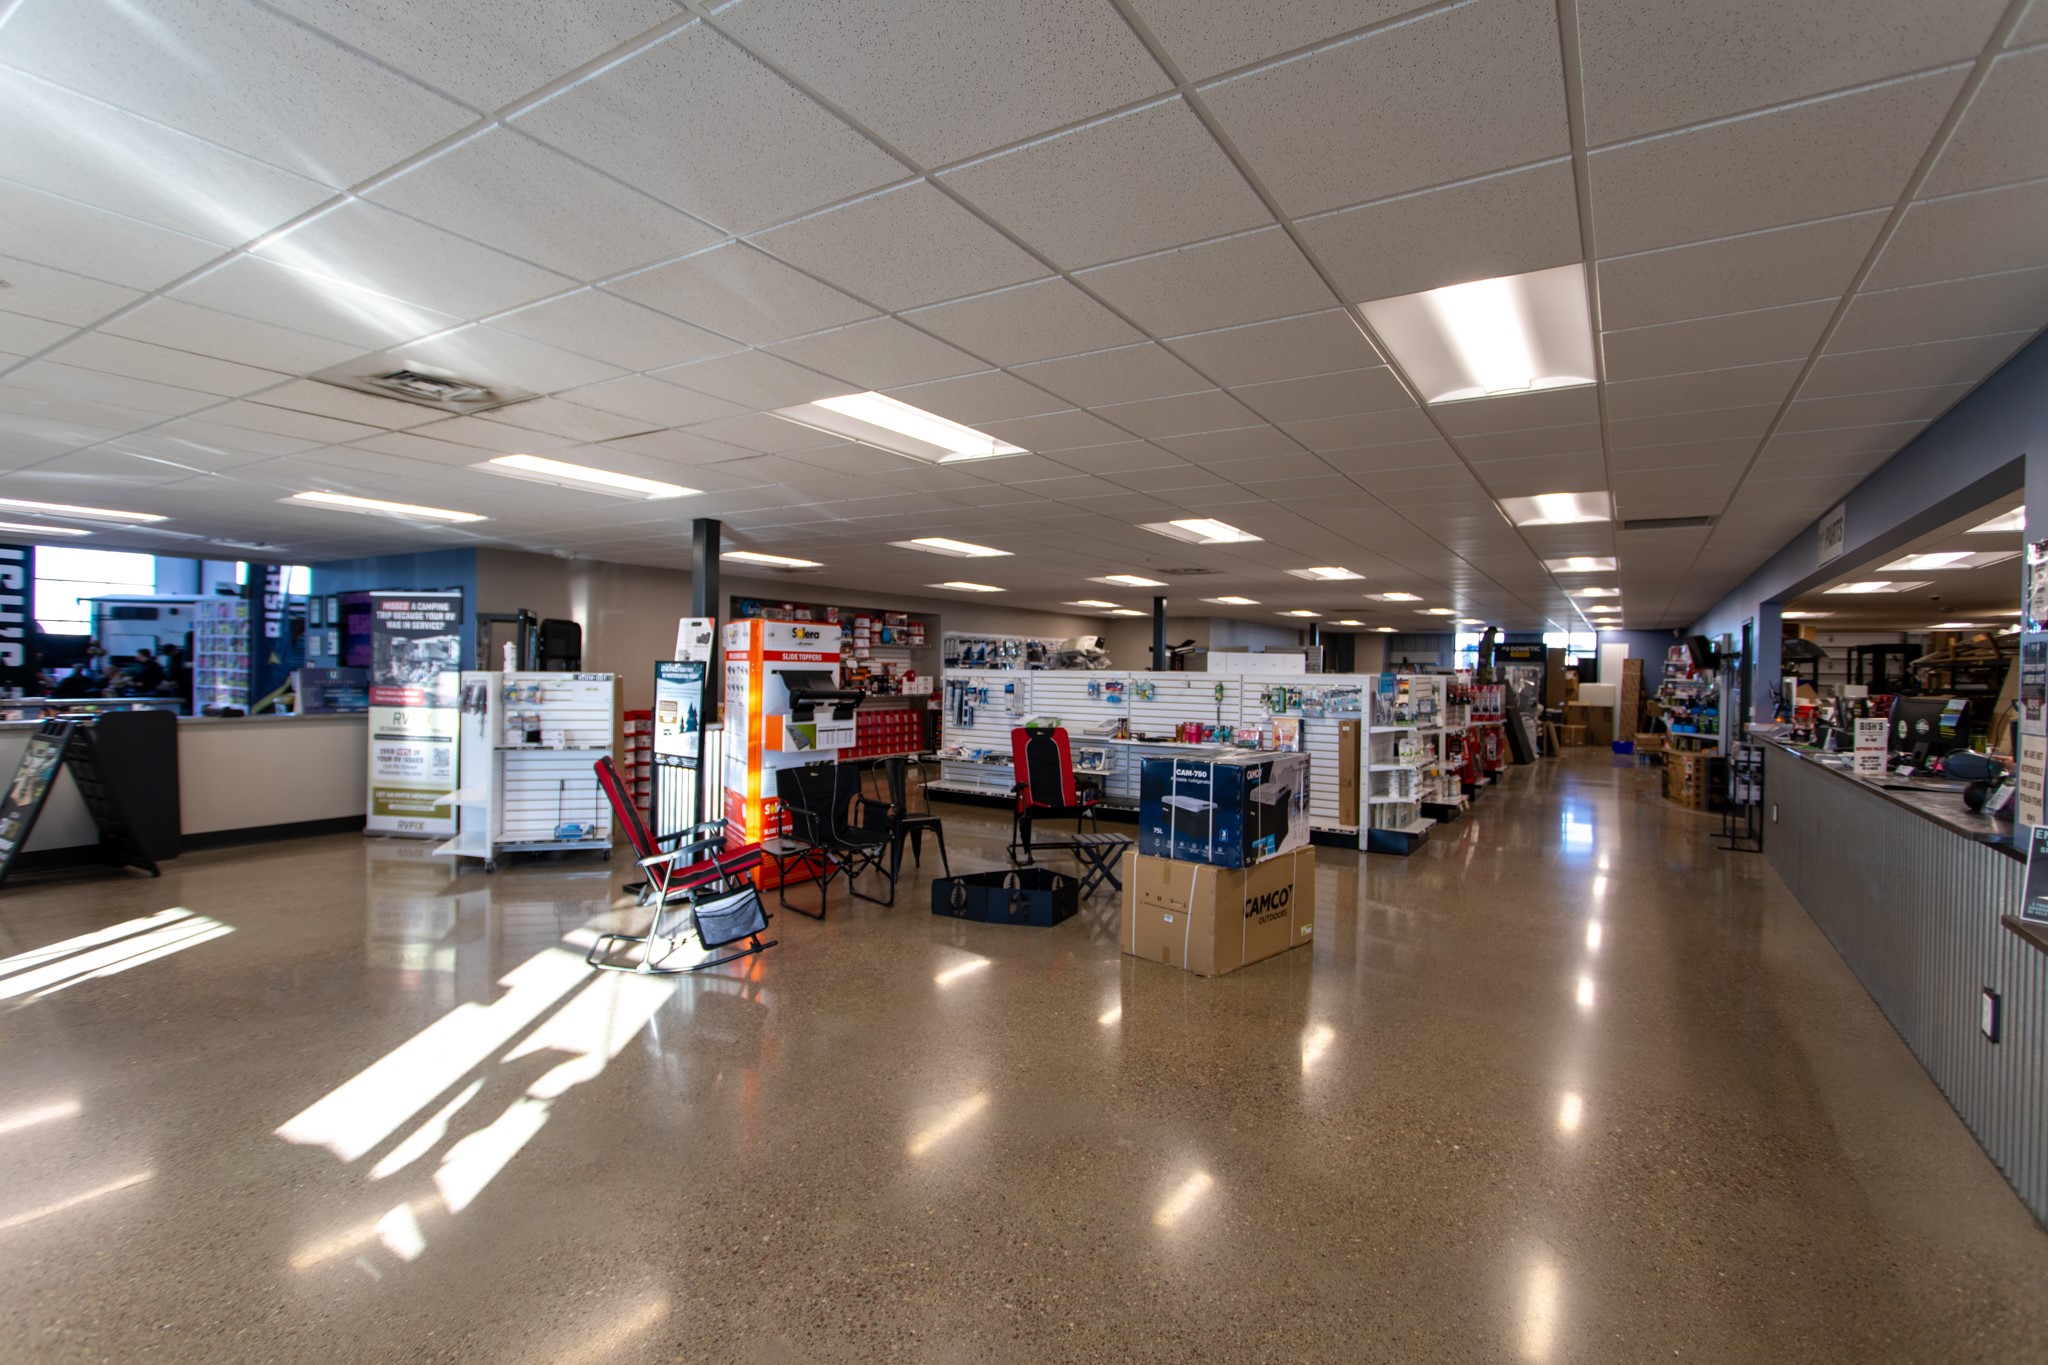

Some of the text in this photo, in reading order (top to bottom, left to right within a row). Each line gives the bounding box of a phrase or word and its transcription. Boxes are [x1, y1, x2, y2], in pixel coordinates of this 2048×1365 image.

[382, 601, 410, 610] MISSED
[417, 602, 450, 611] CAMPING
[376, 611, 456, 621] TRIP BECAUSE YOUR RV
[386, 621, 446, 630] WAS IN SERVICE?
[792, 627, 820, 640] Solera
[799, 653, 822, 661] TOPPERS
[1860, 722, 1883, 731] BISH'S
[398, 820, 424, 830] RVFIX
[1243, 885, 1292, 918] CAMCO
[1258, 909, 1287, 925] OUTDOORS
